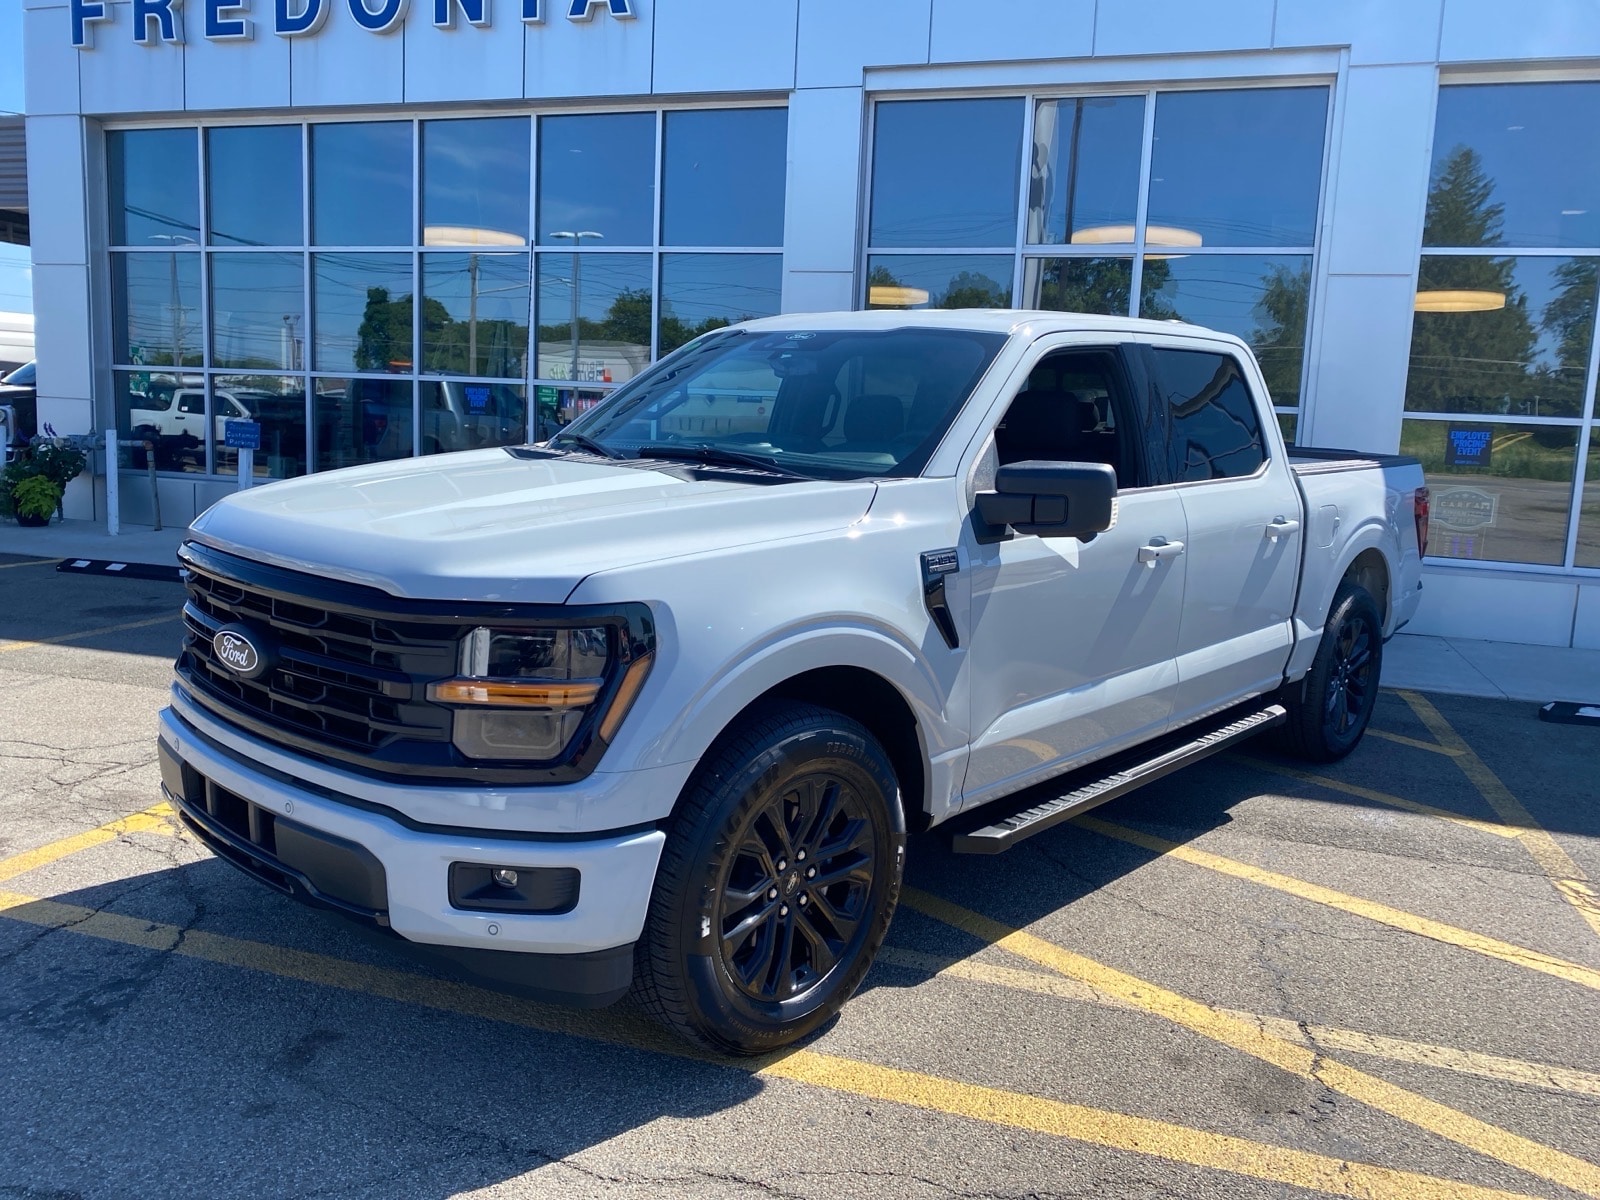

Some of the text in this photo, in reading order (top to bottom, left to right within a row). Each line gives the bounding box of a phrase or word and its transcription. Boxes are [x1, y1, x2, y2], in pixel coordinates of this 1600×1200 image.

[70, 0, 637, 49] FRED
[1450, 431, 1491, 440] EMPLOYEE
[1453, 440, 1487, 448] PRICING
[1457, 448, 1482, 456] EVENT
[221, 635, 249, 667] Ford
[826, 741, 880, 773] TERRITORY
